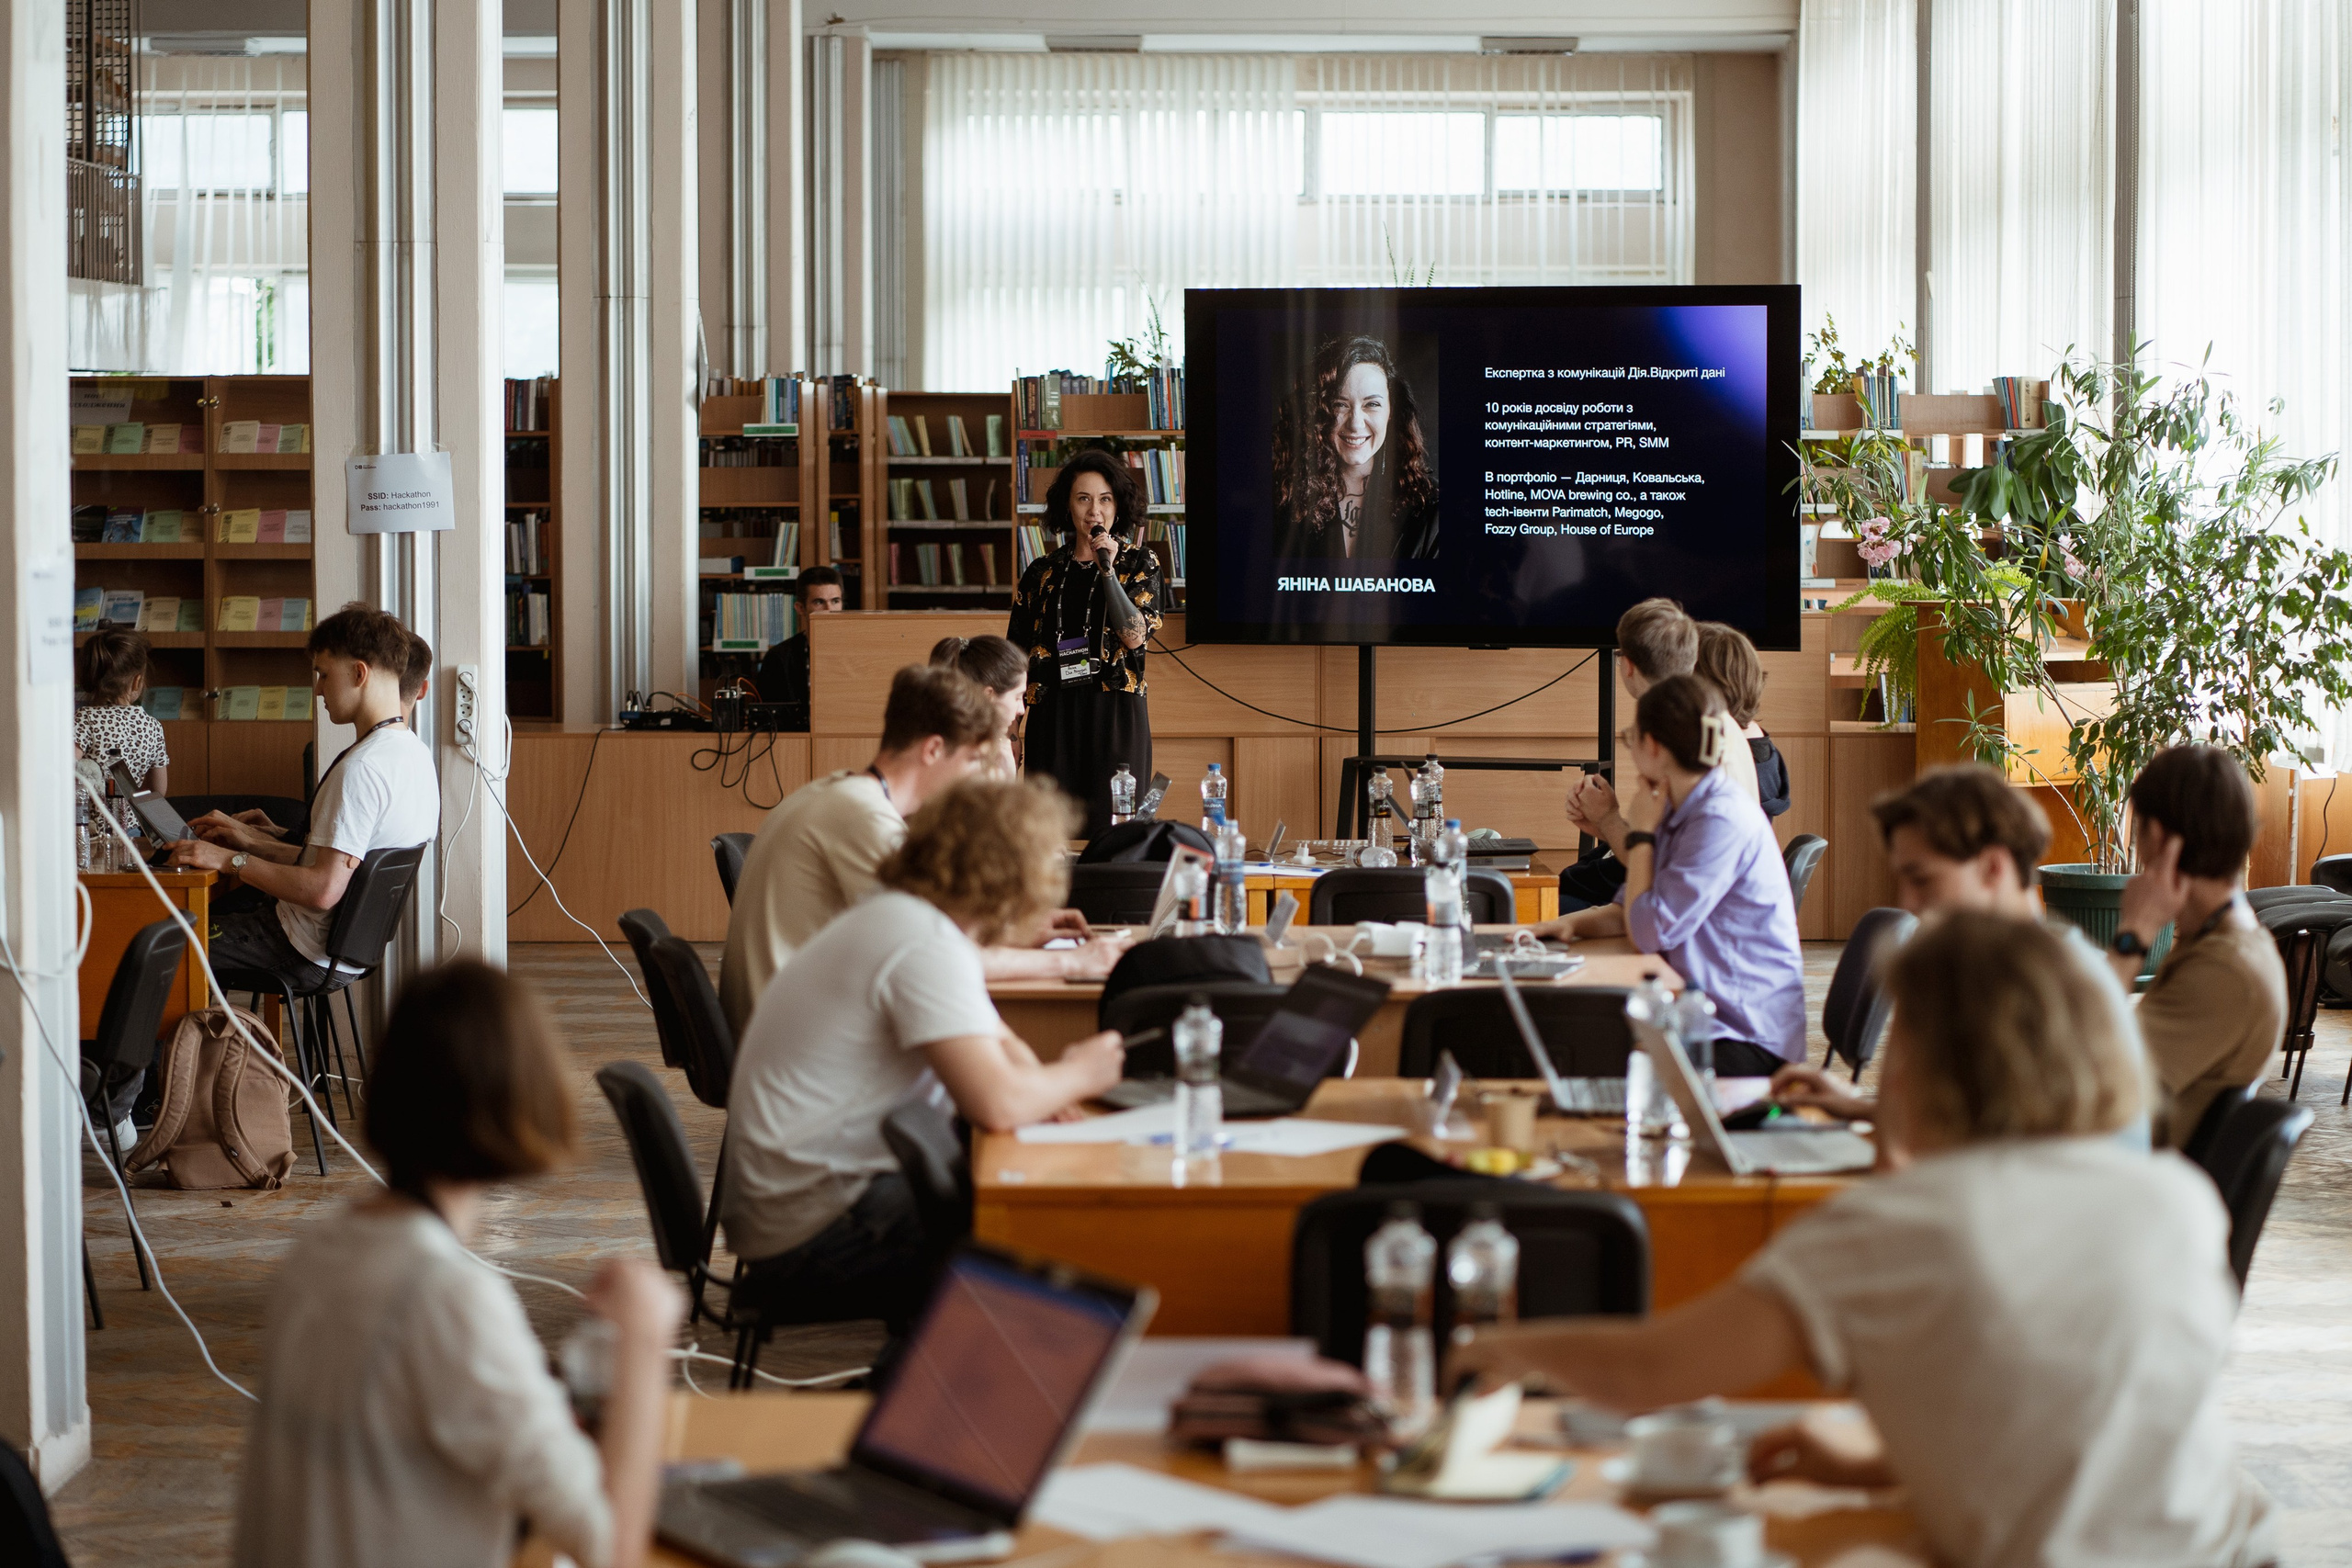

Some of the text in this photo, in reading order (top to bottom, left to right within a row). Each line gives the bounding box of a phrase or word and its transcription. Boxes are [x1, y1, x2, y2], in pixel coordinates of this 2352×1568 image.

[1485, 367, 1725, 381] Експертка з комунікацій Дія.Відкриті дані
[1486, 401, 1634, 416] 10 років досвіду роботи з
[1485, 419, 1657, 434] комунікаційними стратегіями,
[1485, 436, 1669, 451] контент-маркетингом, PR, SMM
[1485, 471, 1494, 482] В
[1497, 471, 1557, 485] портфоліо
[1575, 471, 1630, 485] Дарниця,
[1633, 472, 1705, 485] Ковальська,
[368, 490, 431, 501] SSID: Hackathon
[1485, 489, 1687, 502] Hotline, MOVA brewing co., а також
[382, 501, 440, 511] hackathon1991
[1485, 506, 1665, 521] tech-івенти Parimatch, Megogo,
[1485, 524, 1655, 538] Fozzy Group, House of Europe
[1277, 577, 1437, 592] ЯНІНА ШАБАНОВА
